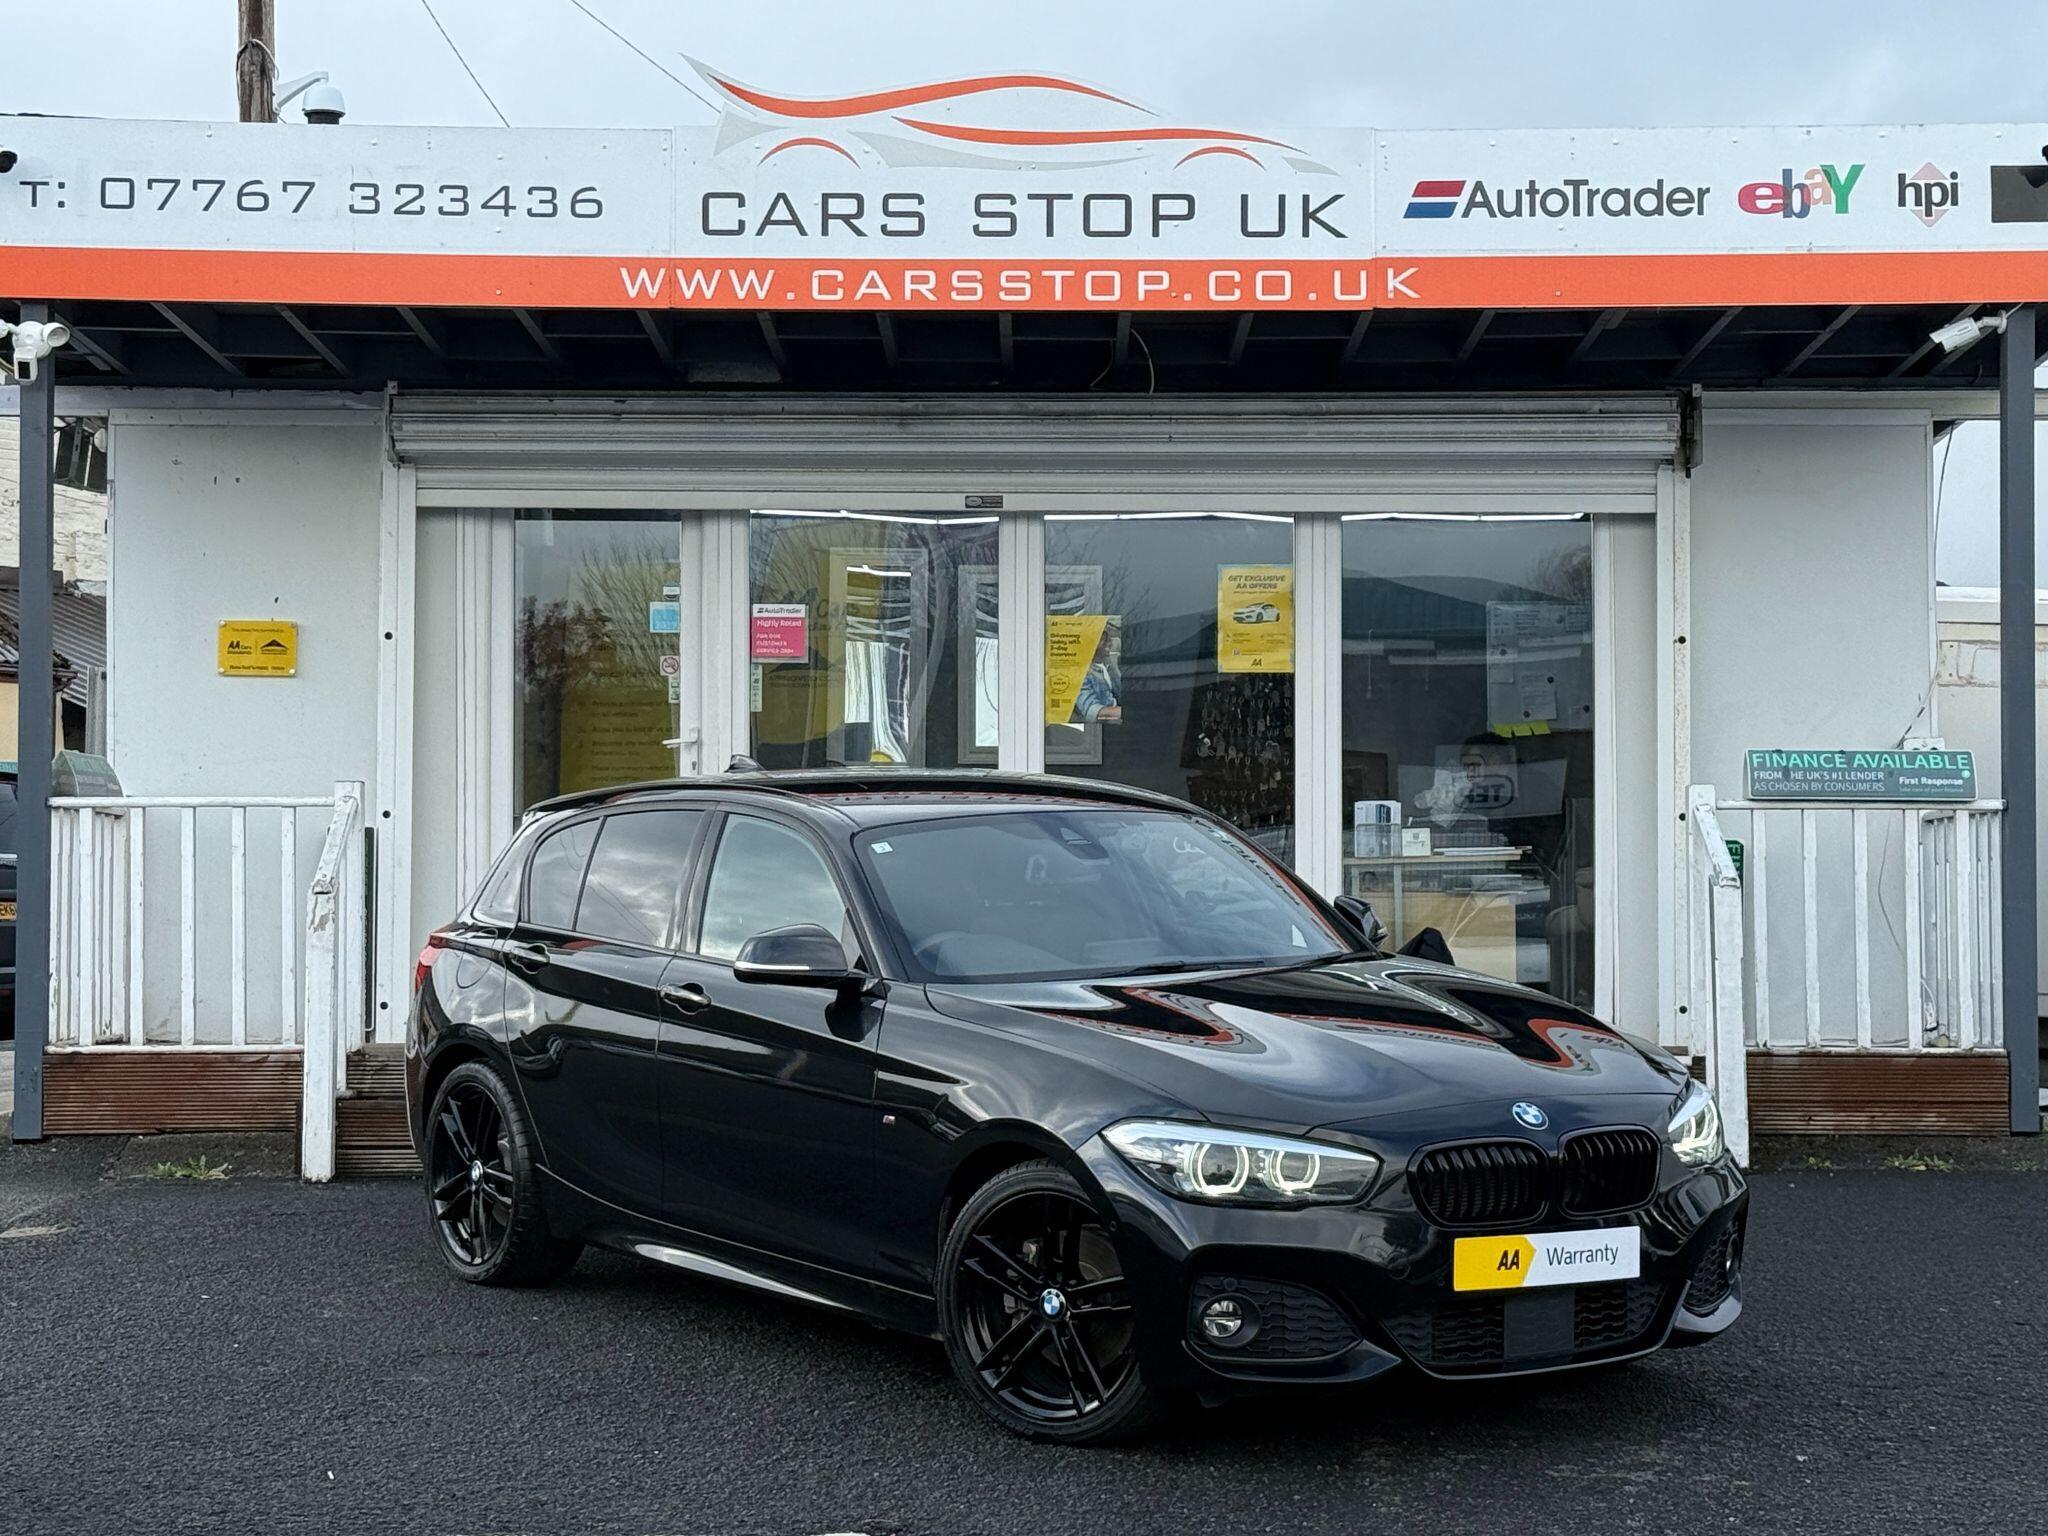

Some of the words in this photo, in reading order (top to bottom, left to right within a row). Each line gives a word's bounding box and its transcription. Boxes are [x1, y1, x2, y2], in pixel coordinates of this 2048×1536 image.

[19, 180, 66, 208] T:
[100, 177, 317, 214] 07767
[348, 181, 604, 219] 323436
[1461, 178, 1710, 219] AutoTrader
[1897, 171, 1960, 219] hpi
[701, 191, 926, 238] CARS
[972, 192, 1196, 238] STOP
[1239, 192, 1349, 239] UK
[619, 265, 1423, 302] WWW.CARSSTOP.CO.UK
[756, 620, 779, 628] Highly
[227, 640, 240, 650] AA
[1251, 658, 1263, 667] AA
[1752, 752, 1847, 768] FINANCE
[1853, 753, 1970, 770] AVAILABLE
[1754, 771, 1782, 780] FROM
[1806, 771, 1830, 780] UK'S
[1845, 771, 1885, 781] LENDER
[1899, 776, 1919, 785] First
[1921, 777, 1964, 787] Response
[1754, 781, 1767, 791] AS
[1768, 781, 1809, 791] CHOSEN
[1811, 782, 1824, 791] BY
[1824, 782, 1886, 792] CONSUMERS
[1496, 1249, 1521, 1272] AA
[1546, 1243, 1619, 1266] Warranty
